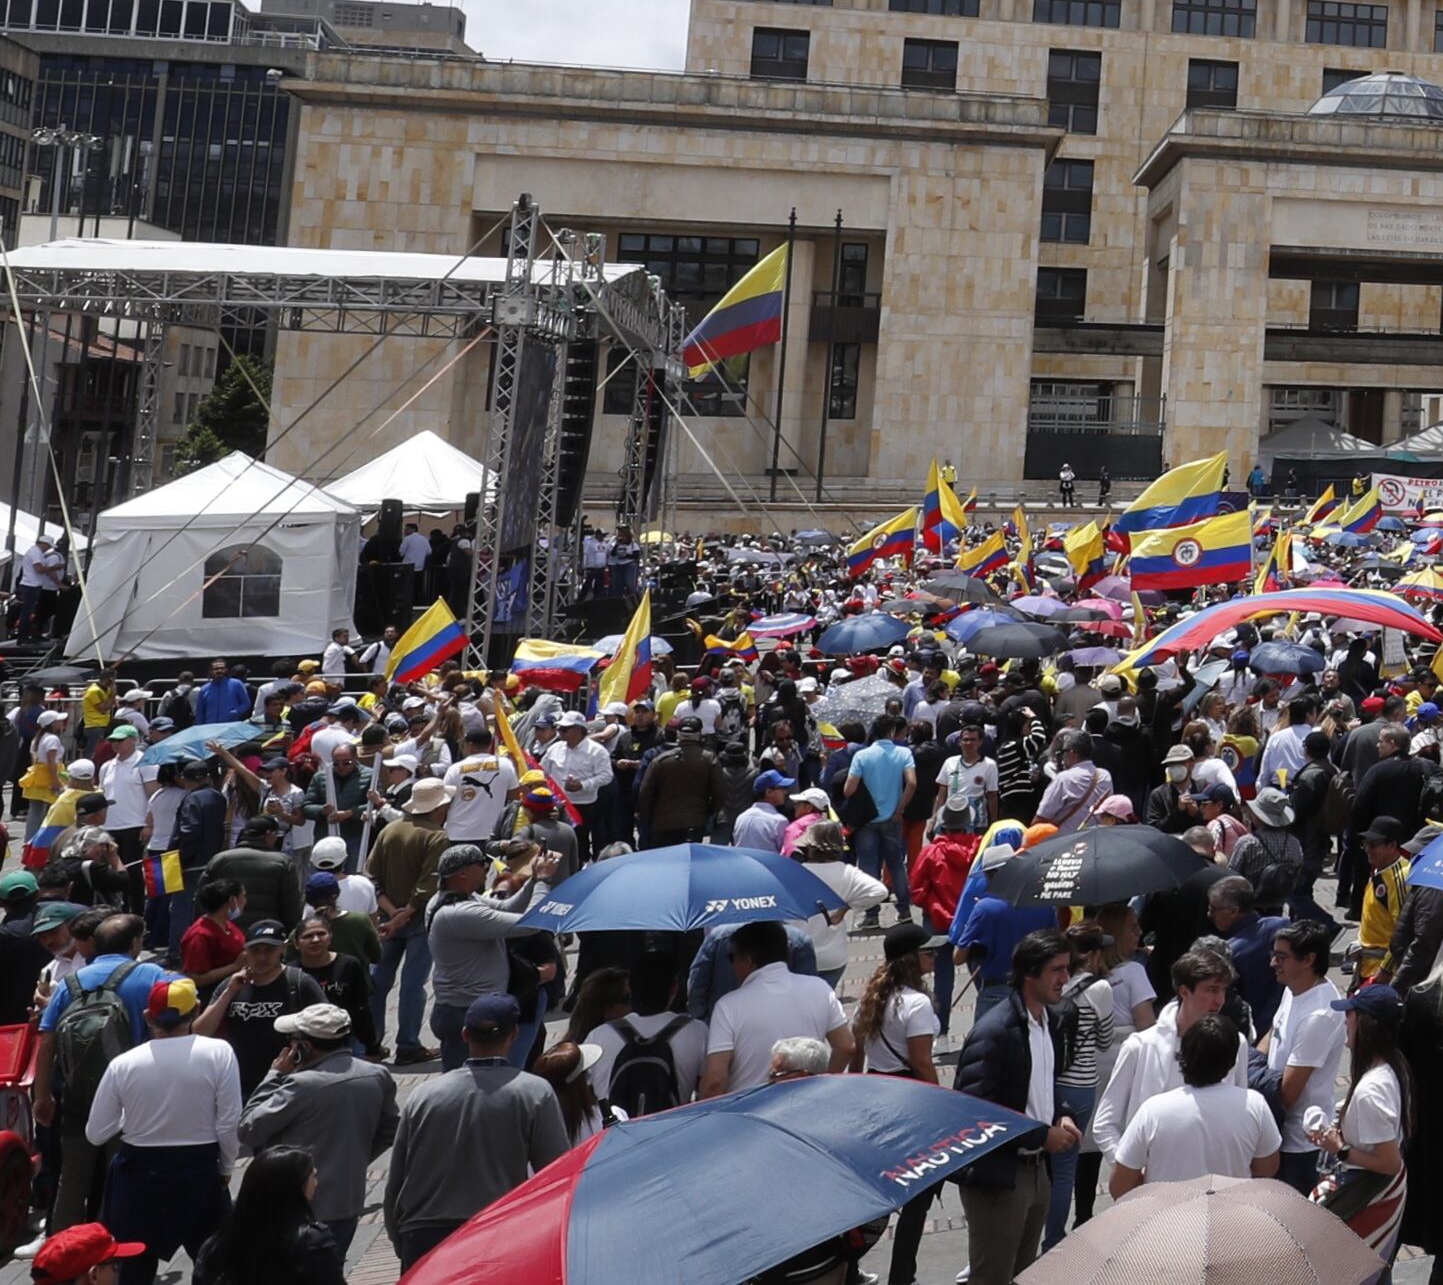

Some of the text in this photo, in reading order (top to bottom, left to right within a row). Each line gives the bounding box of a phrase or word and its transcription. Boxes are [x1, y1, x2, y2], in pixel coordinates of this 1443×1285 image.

[1407, 479, 1438, 487] PETRO
[1053, 858, 1083, 866] LLUEVA
[1046, 871, 1079, 879] NO HAY
[1052, 891, 1073, 899] PARE
[731, 895, 777, 910] YONEX
[883, 1120, 1008, 1187] NAUTICA
